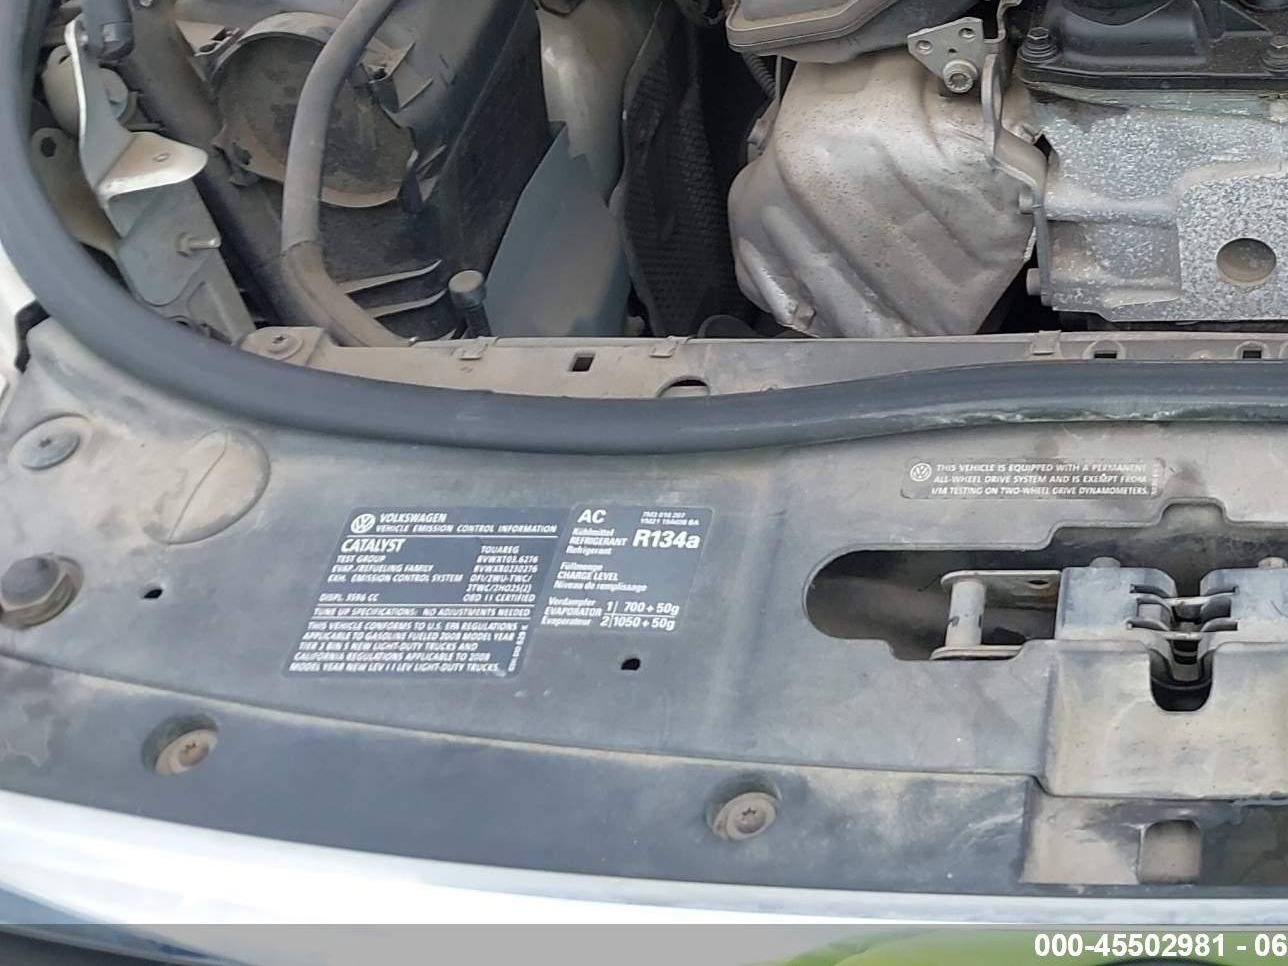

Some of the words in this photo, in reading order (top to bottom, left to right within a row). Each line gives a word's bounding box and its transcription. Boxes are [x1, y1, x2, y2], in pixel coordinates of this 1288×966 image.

[936, 464, 957, 472] THIS
[959, 464, 995, 472] VEHICLE
[997, 464, 1006, 472] IS
[1008, 464, 1053, 472] EQUIPPED
[1055, 464, 1079, 472] WITH
[1082, 464, 1089, 472] A
[1091, 464, 1147, 472] PERMANENT
[933, 475, 982, 483] ALL-WHEEL
[984, 475, 1011, 483] DRIVE
[1013, 475, 1047, 483] SYSTEM
[1049, 475, 1070, 483] AND
[1072, 475, 1081, 483] IS
[1082, 475, 1119, 483] EXEMPT
[1120, 475, 1147, 483] FROM
[380, 513, 448, 523] VOLKSWAGEN
[577, 509, 607, 523] AC
[375, 525, 411, 533] VEHICLE
[412, 525, 455, 533] EMISSION
[456, 525, 495, 533] CONTROL
[498, 525, 558, 533] INFORMATION
[569, 536, 628, 546] REFRIGERANT
[632, 529, 701, 549] R134a
[341, 538, 406, 553] CATALYST
[481, 546, 519, 554] TOUAREG
[392, 574, 430, 582] CONTROL
[431, 574, 463, 582] SYSTEM
[557, 571, 593, 580] CHARGE
[593, 571, 619, 580] LEVEL
[462, 593, 483, 602] OBD
[495, 593, 536, 602] CERTIFIED
[437, 607, 497, 616] ADJUSTMENTS
[497, 607, 531, 616] NEEDED
[544, 606, 603, 617] EVAPORATOR
[624, 602, 646, 612] 700
[656, 603, 680, 616] 50g
[328, 621, 364, 630] VEHICLE
[413, 622, 426, 630] TO
[460, 622, 518, 631] REGULATIONS
[613, 617, 642, 627] 1050
[651, 618, 676, 631] 50g
[461, 633, 492, 641] MODEL
[493, 633, 516, 641] YEAR
[457, 643, 478, 651] AND
[455, 652, 468, 661] TO
[466, 662, 500, 672] TRUCKS
